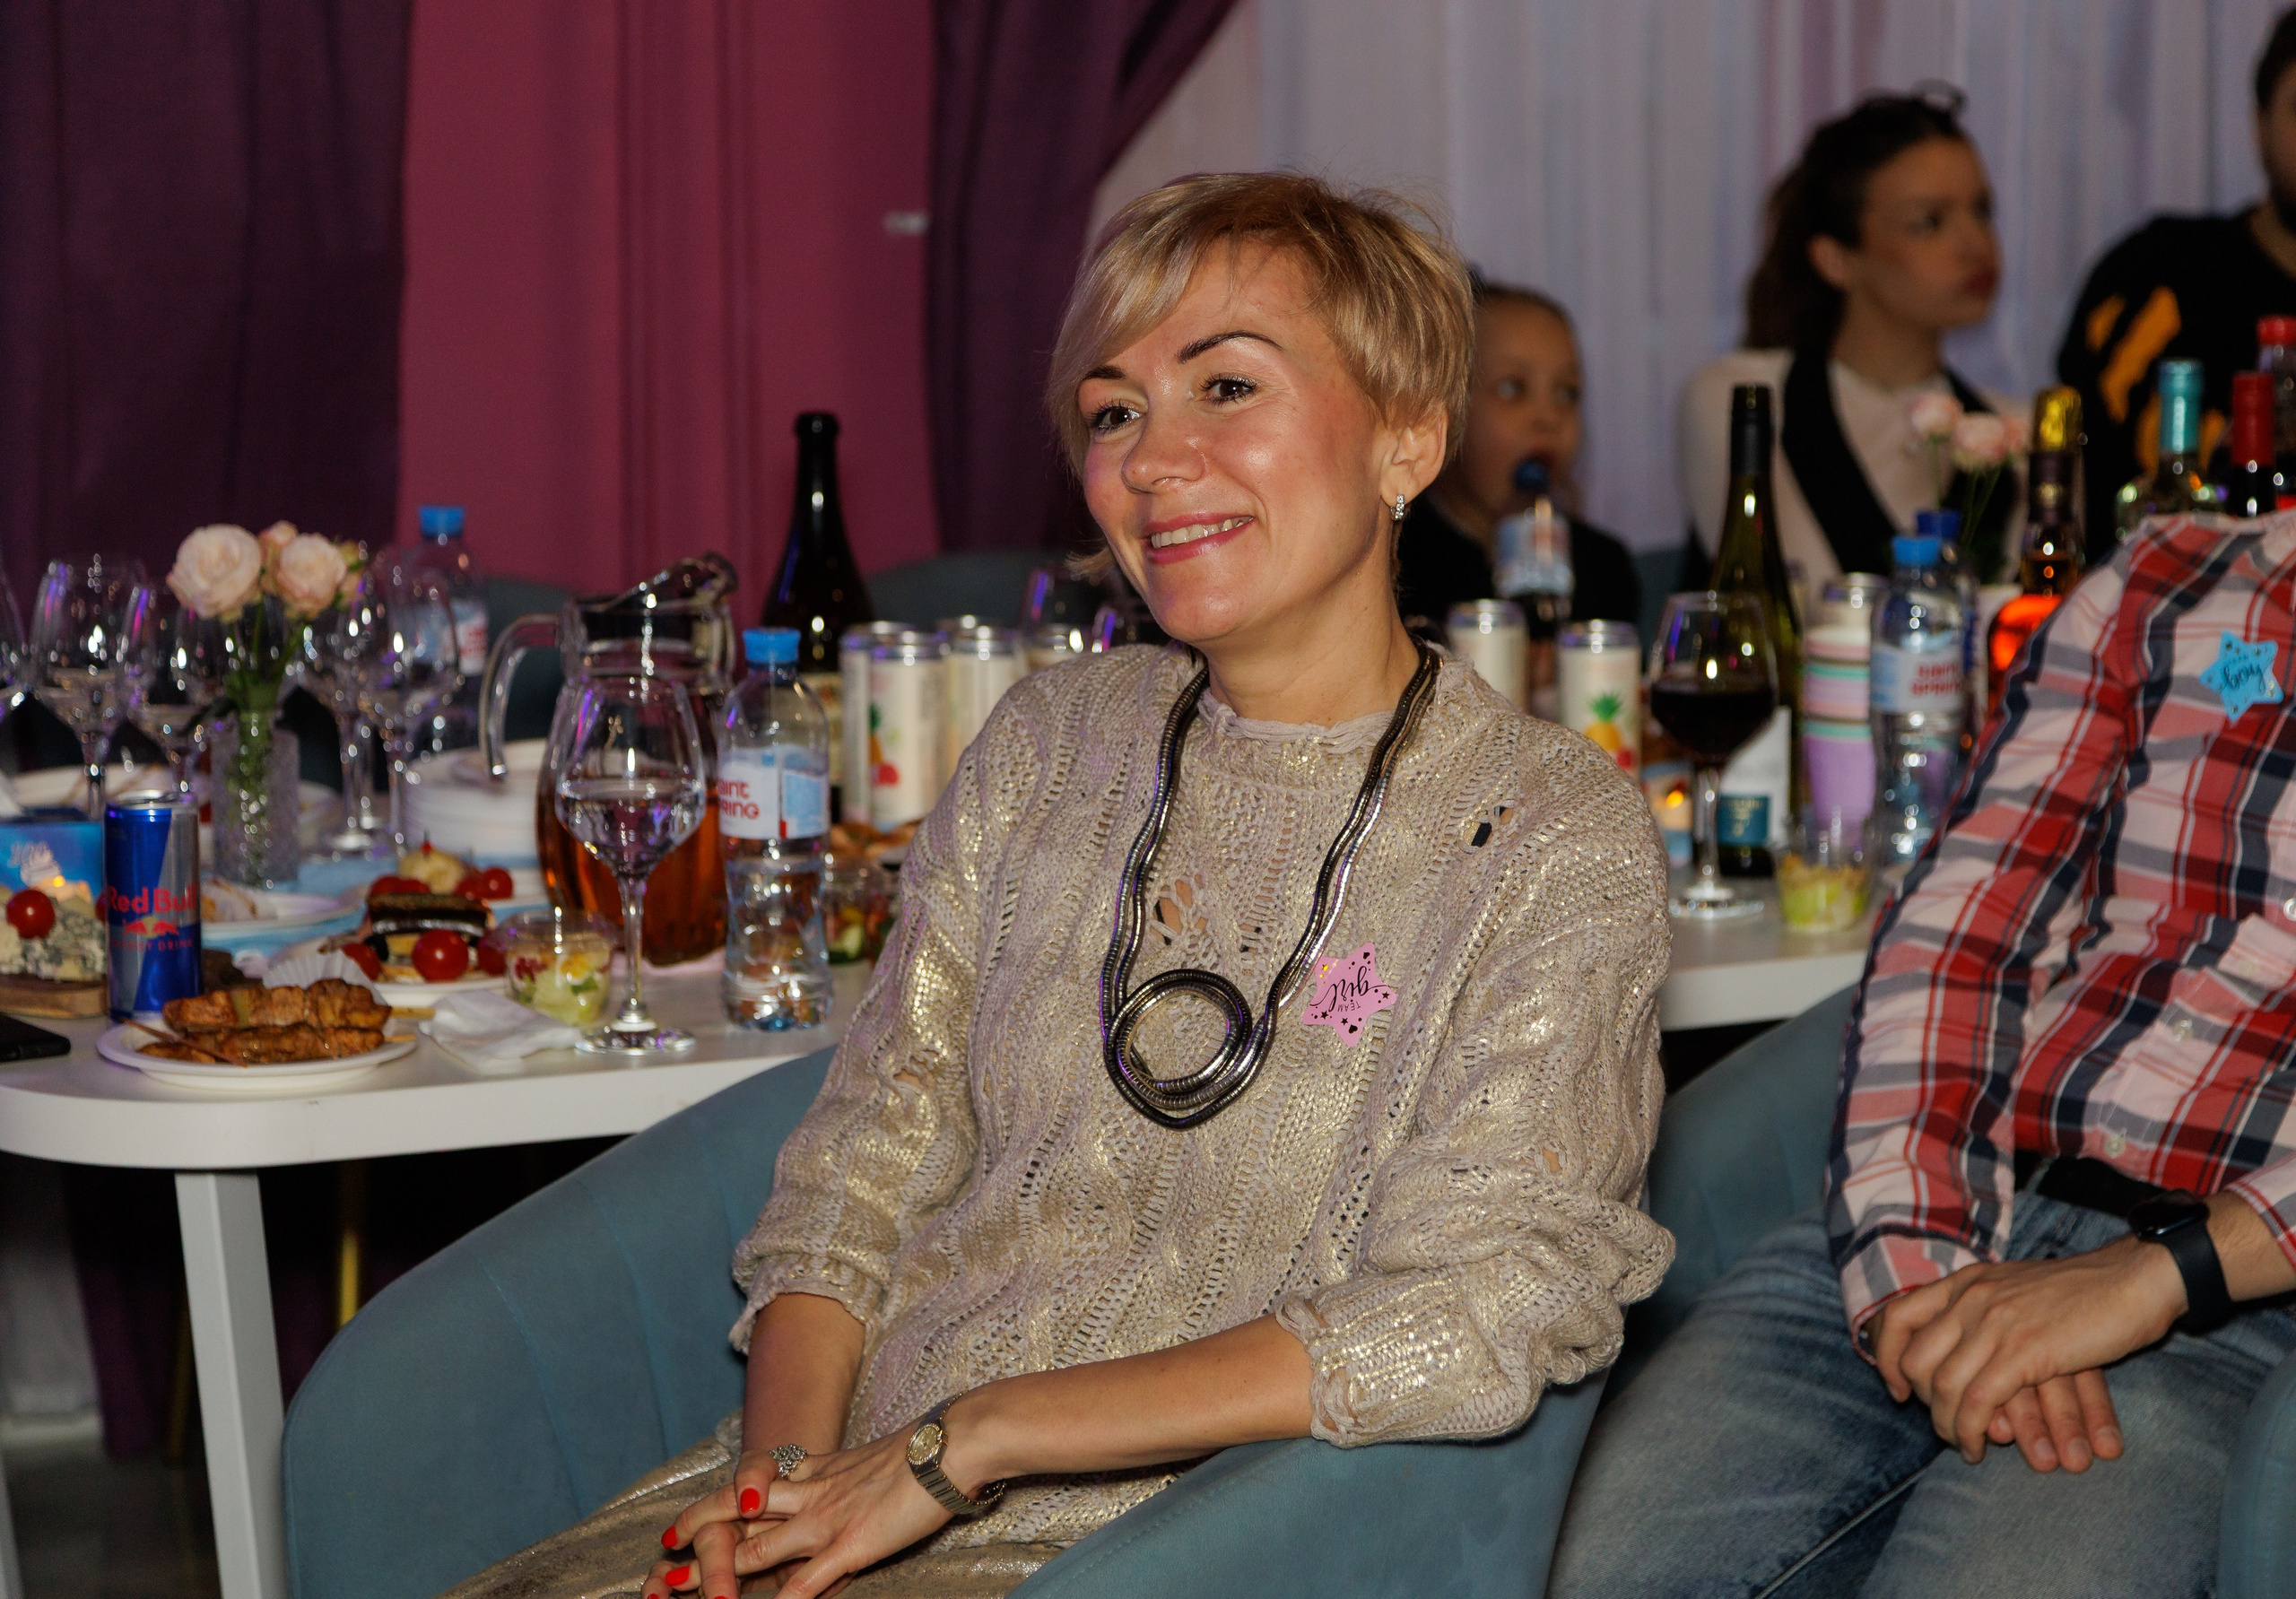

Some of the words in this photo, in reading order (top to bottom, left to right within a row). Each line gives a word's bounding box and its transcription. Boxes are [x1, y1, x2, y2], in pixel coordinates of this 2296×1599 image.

[108, 885, 149, 913] Red
[153, 883, 197, 913] Bull
[1309, 966, 1387, 1012] girl
[1337, 1001, 1361, 1012] TEAM
